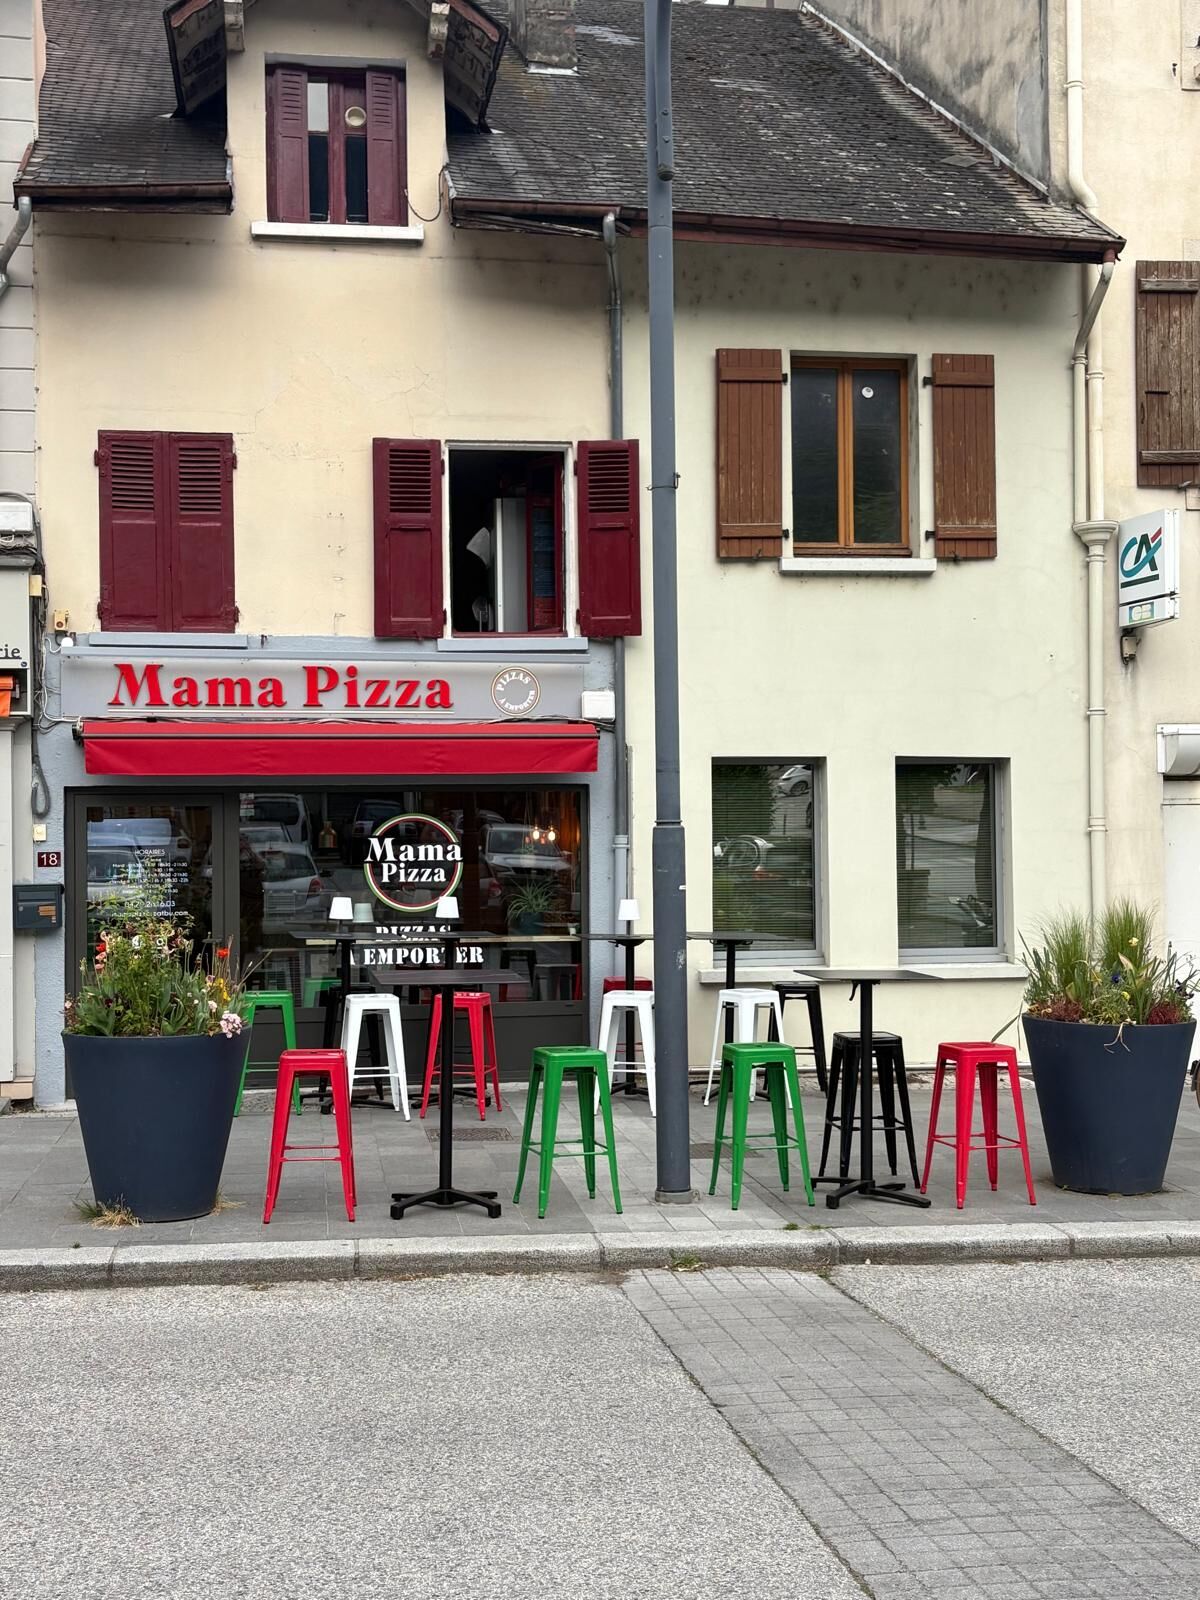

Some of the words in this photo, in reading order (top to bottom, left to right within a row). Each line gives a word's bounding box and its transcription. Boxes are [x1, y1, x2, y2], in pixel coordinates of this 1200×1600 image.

[1120, 527, 1162, 578] CA
[111, 663, 287, 707] Mama
[303, 665, 454, 708] Pizza
[496, 672, 531, 691] PIZZAS
[504, 690, 536, 711] EMPORTER
[40, 853, 58, 866] 18
[364, 837, 463, 862] Mama
[381, 862, 447, 883] Pizza
[363, 946, 485, 966] EMPORER
